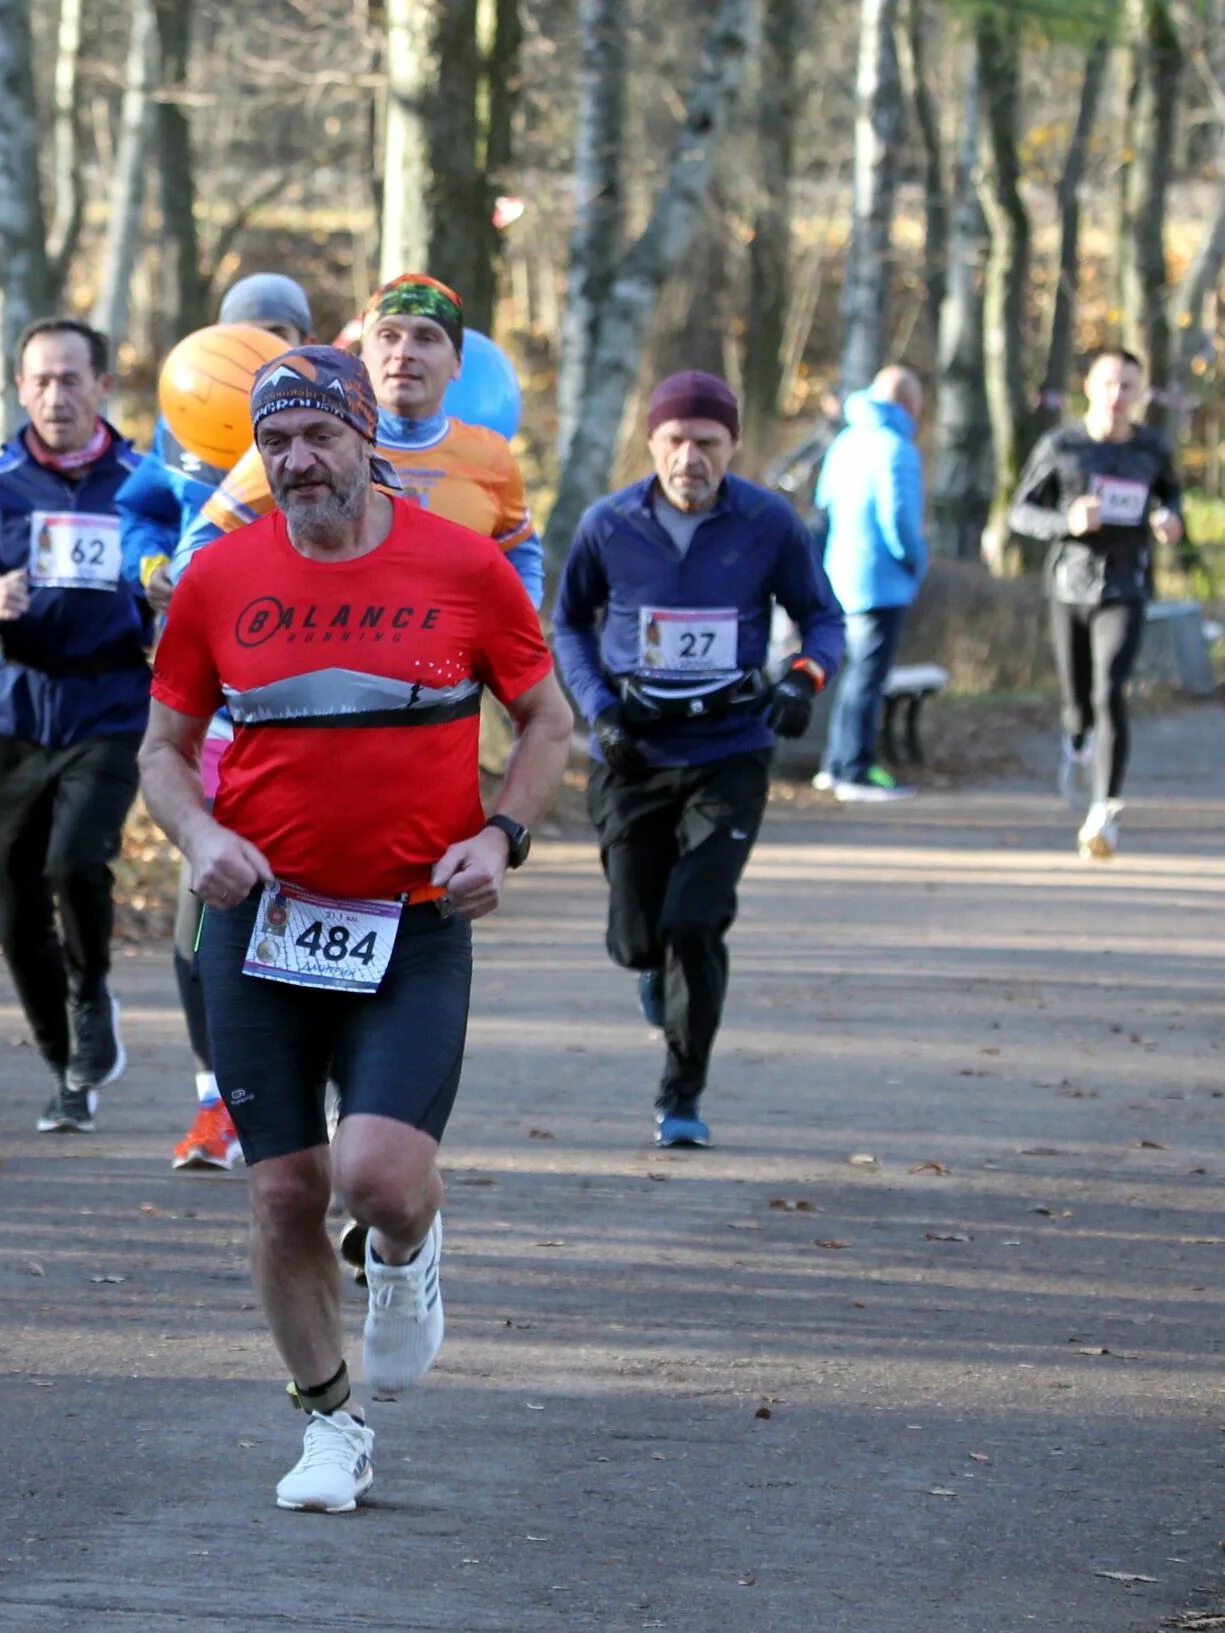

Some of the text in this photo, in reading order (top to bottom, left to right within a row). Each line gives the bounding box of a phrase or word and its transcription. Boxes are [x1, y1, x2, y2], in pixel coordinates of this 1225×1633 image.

[71, 538, 105, 566] 62
[246, 603, 441, 635] BALANCE
[679, 633, 717, 658] 27
[296, 920, 377, 966] 484
